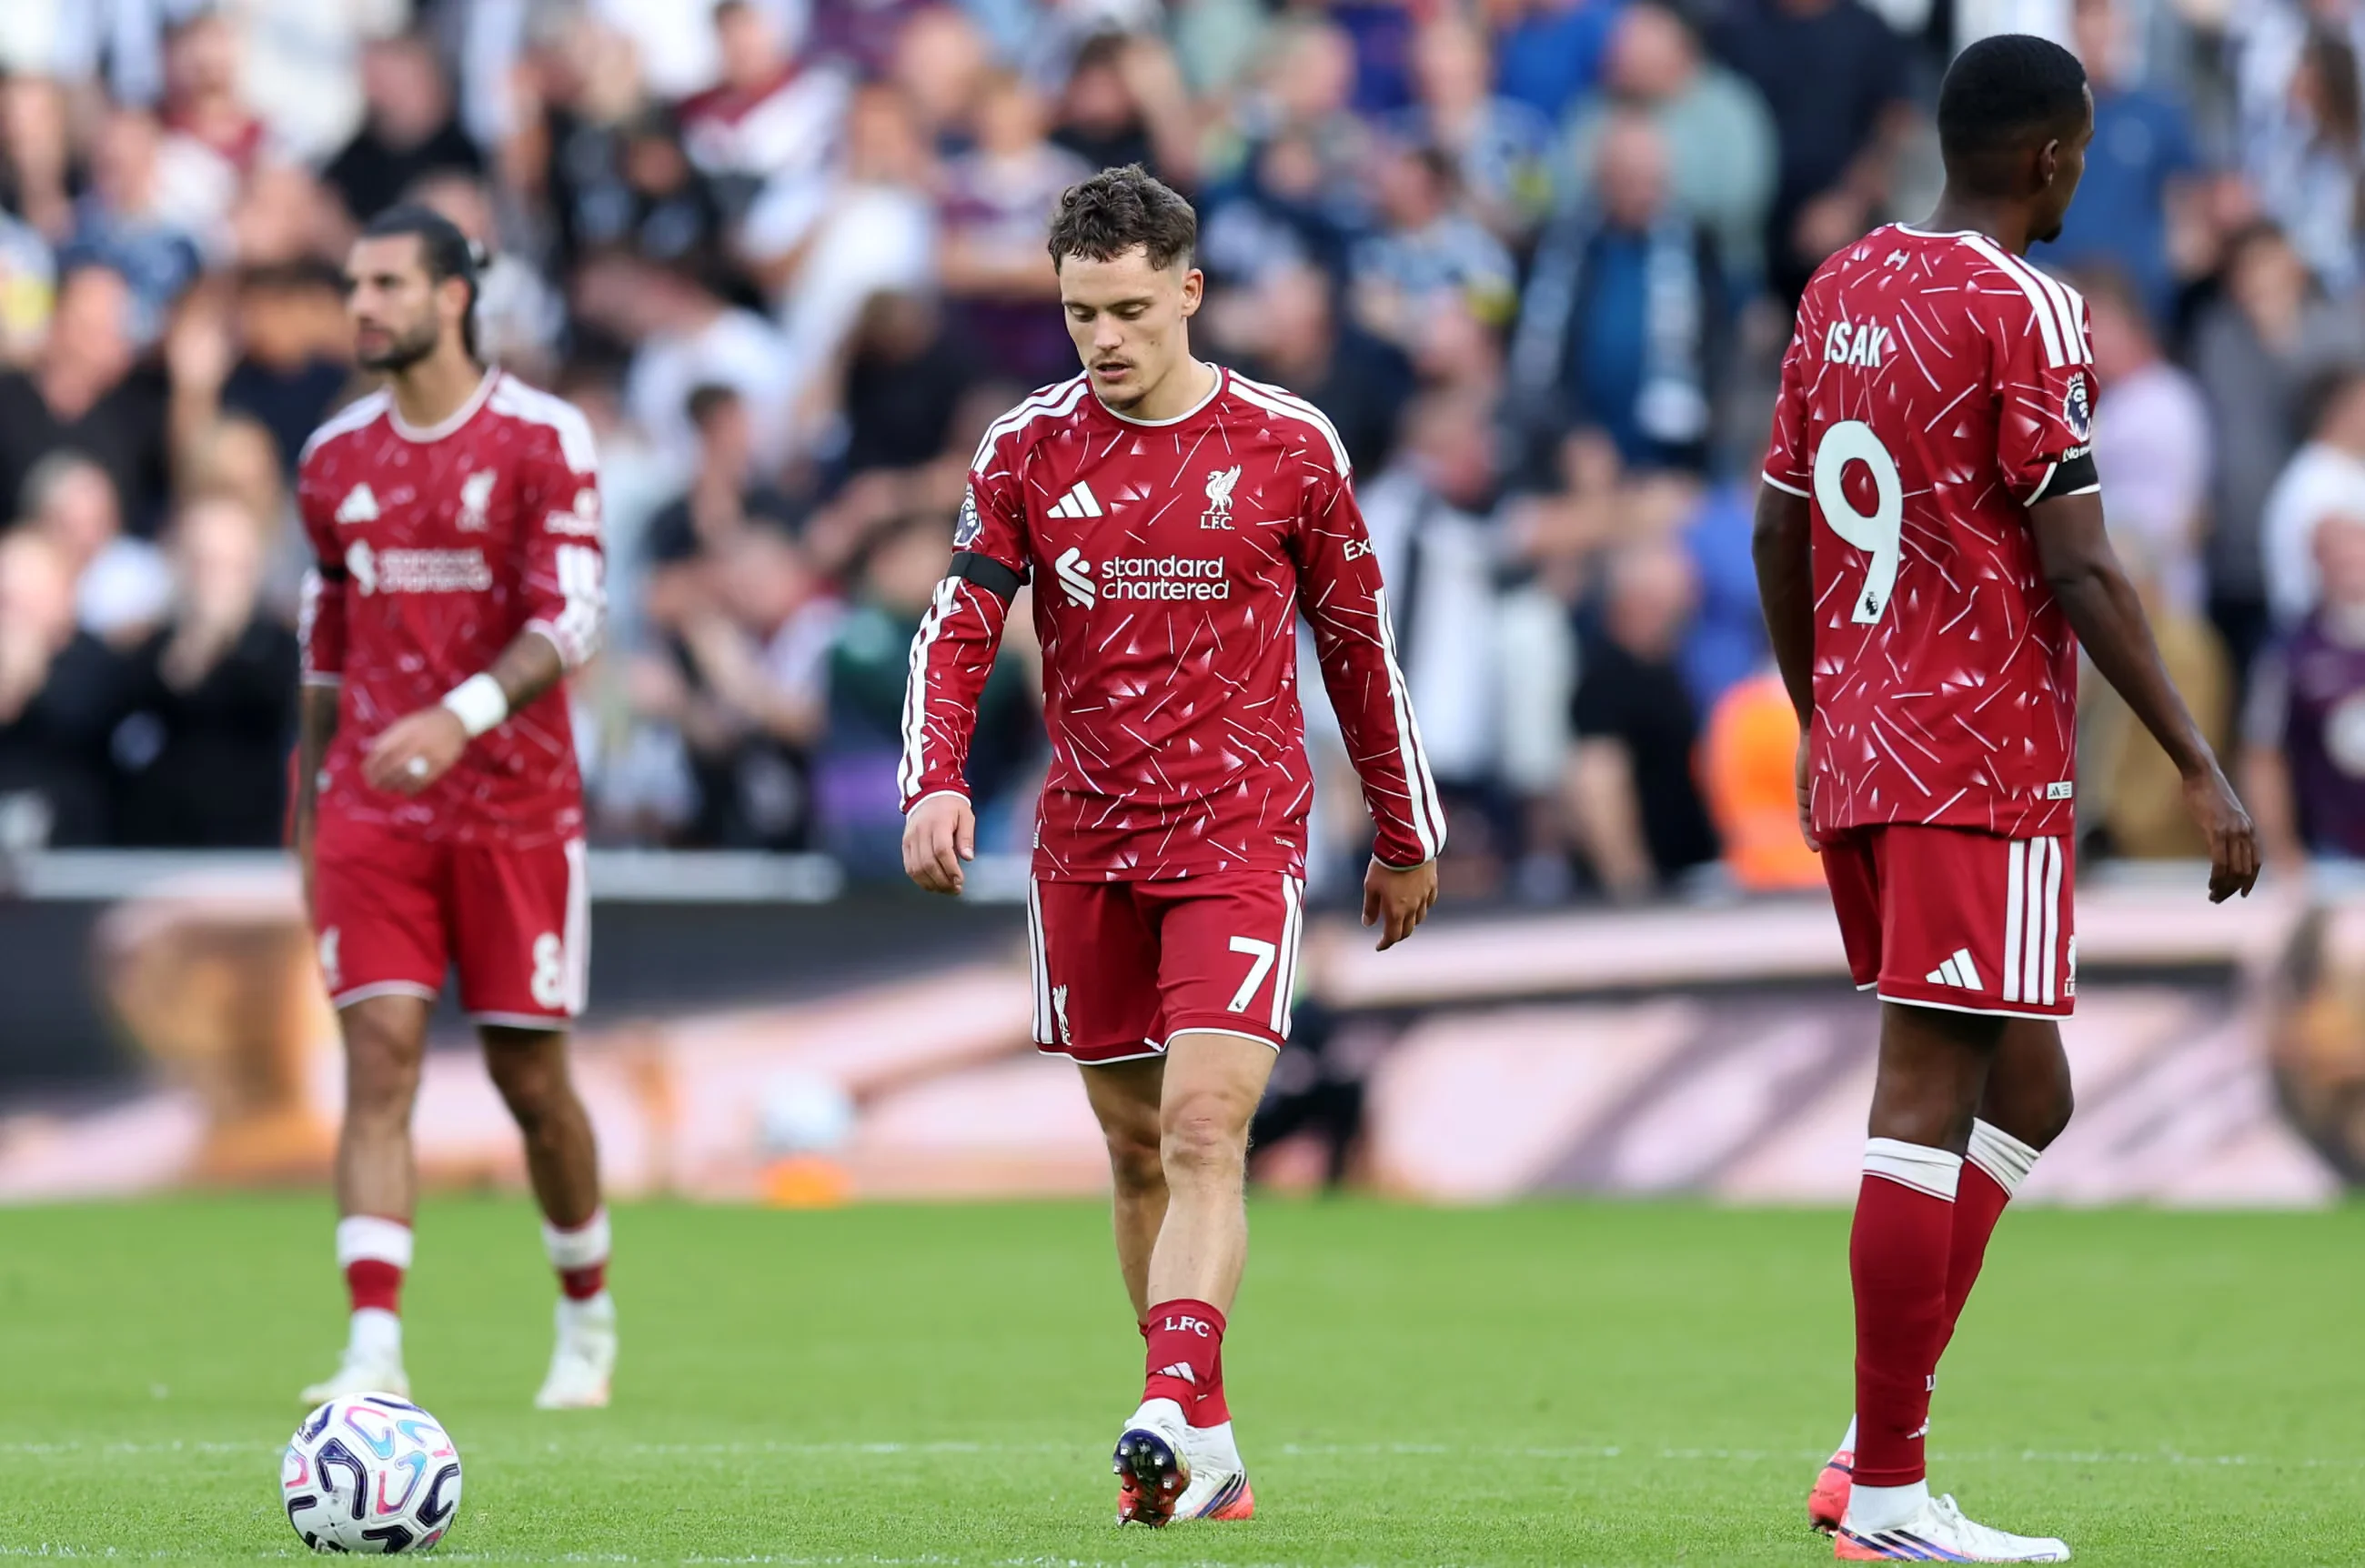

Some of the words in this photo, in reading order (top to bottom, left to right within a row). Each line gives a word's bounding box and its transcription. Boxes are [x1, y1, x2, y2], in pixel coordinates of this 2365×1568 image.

[1824, 320, 1889, 368] ISAK
[1813, 419, 1903, 625] 9
[1102, 555, 1224, 579] standard
[1102, 578, 1230, 600] chartered
[530, 930, 568, 1009] 8
[1226, 935, 1277, 1013] 7
[1164, 1315, 1210, 1338] LFC
